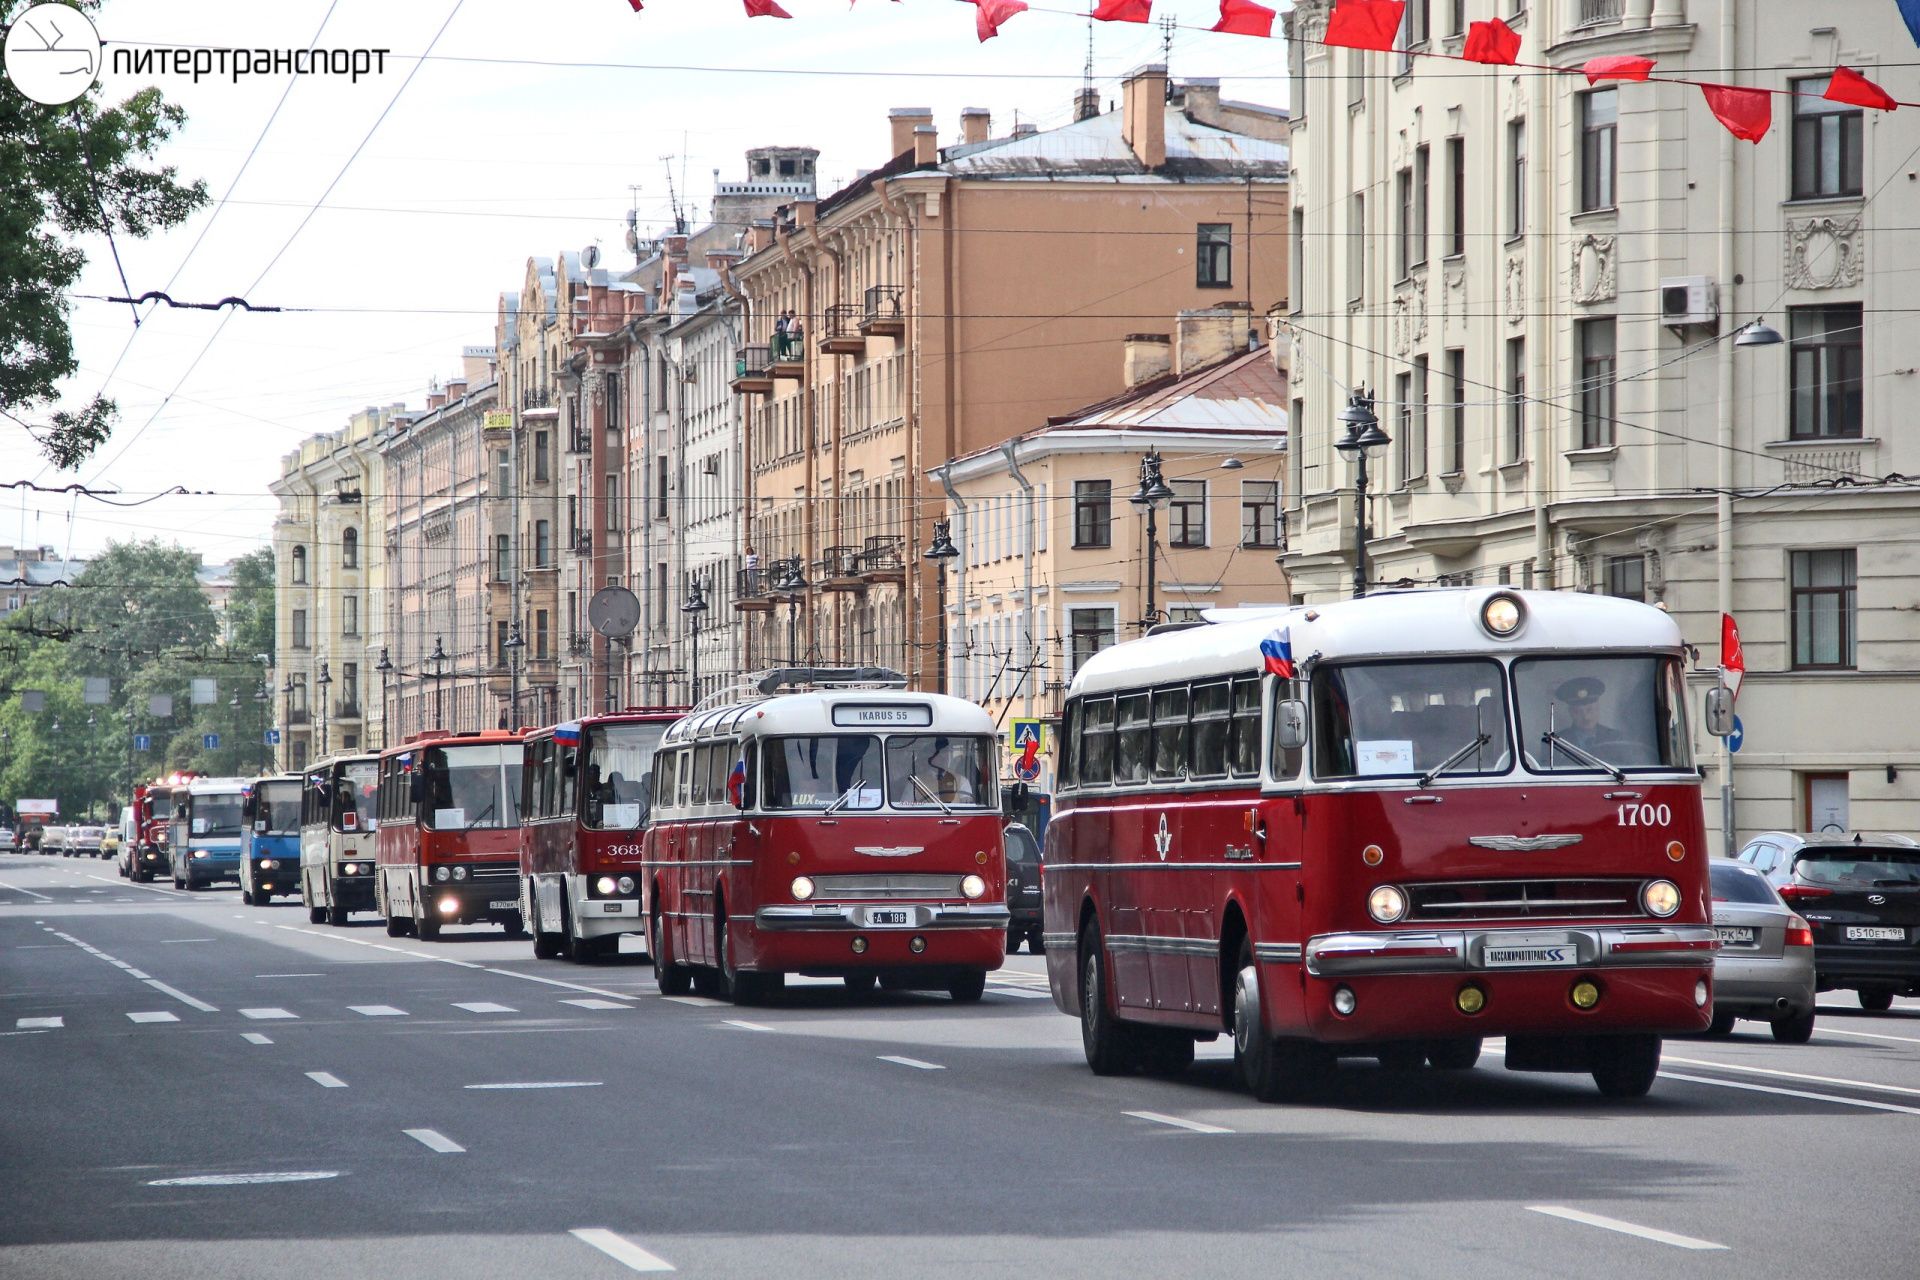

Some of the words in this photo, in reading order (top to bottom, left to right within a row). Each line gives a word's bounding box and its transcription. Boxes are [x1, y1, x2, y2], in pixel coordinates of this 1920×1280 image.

[859, 711, 893, 720] IKARUS
[896, 711, 908, 720] 55
[792, 794, 815, 805] LUX
[1617, 803, 1671, 826] 1700
[890, 913, 904, 923] 188
[1738, 929, 1749, 937] 47
